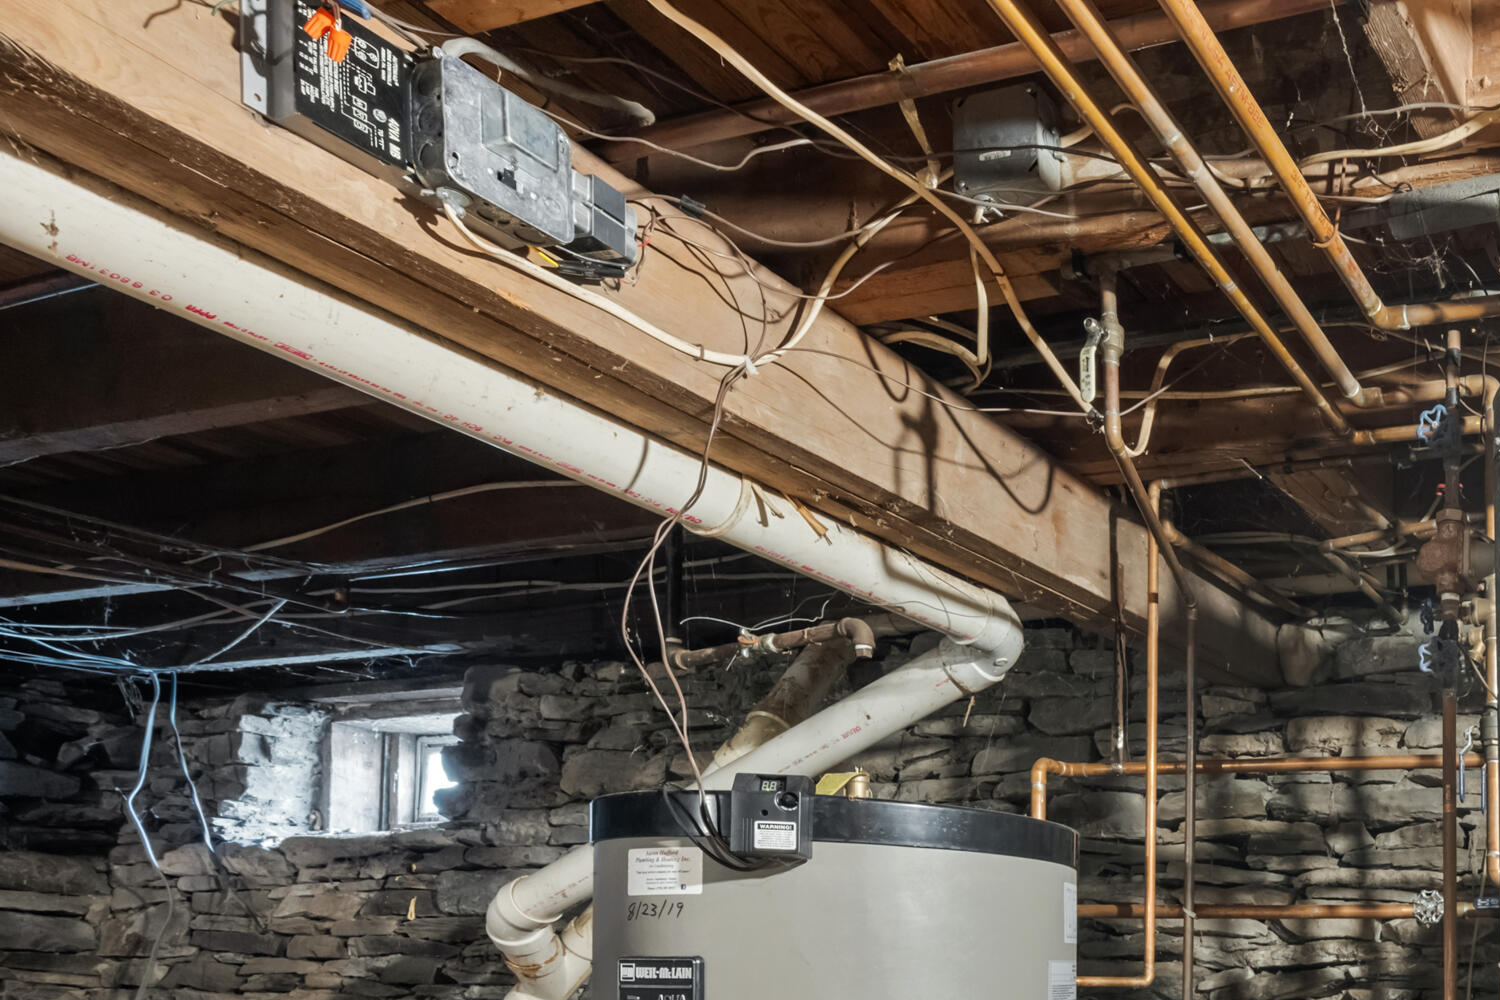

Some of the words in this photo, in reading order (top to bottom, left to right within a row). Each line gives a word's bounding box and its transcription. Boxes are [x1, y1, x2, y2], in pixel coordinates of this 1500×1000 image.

[388, 118, 400, 142] 40VA
[390, 142, 401, 160] MB
[627, 899, 684, 920] 8/23/19
